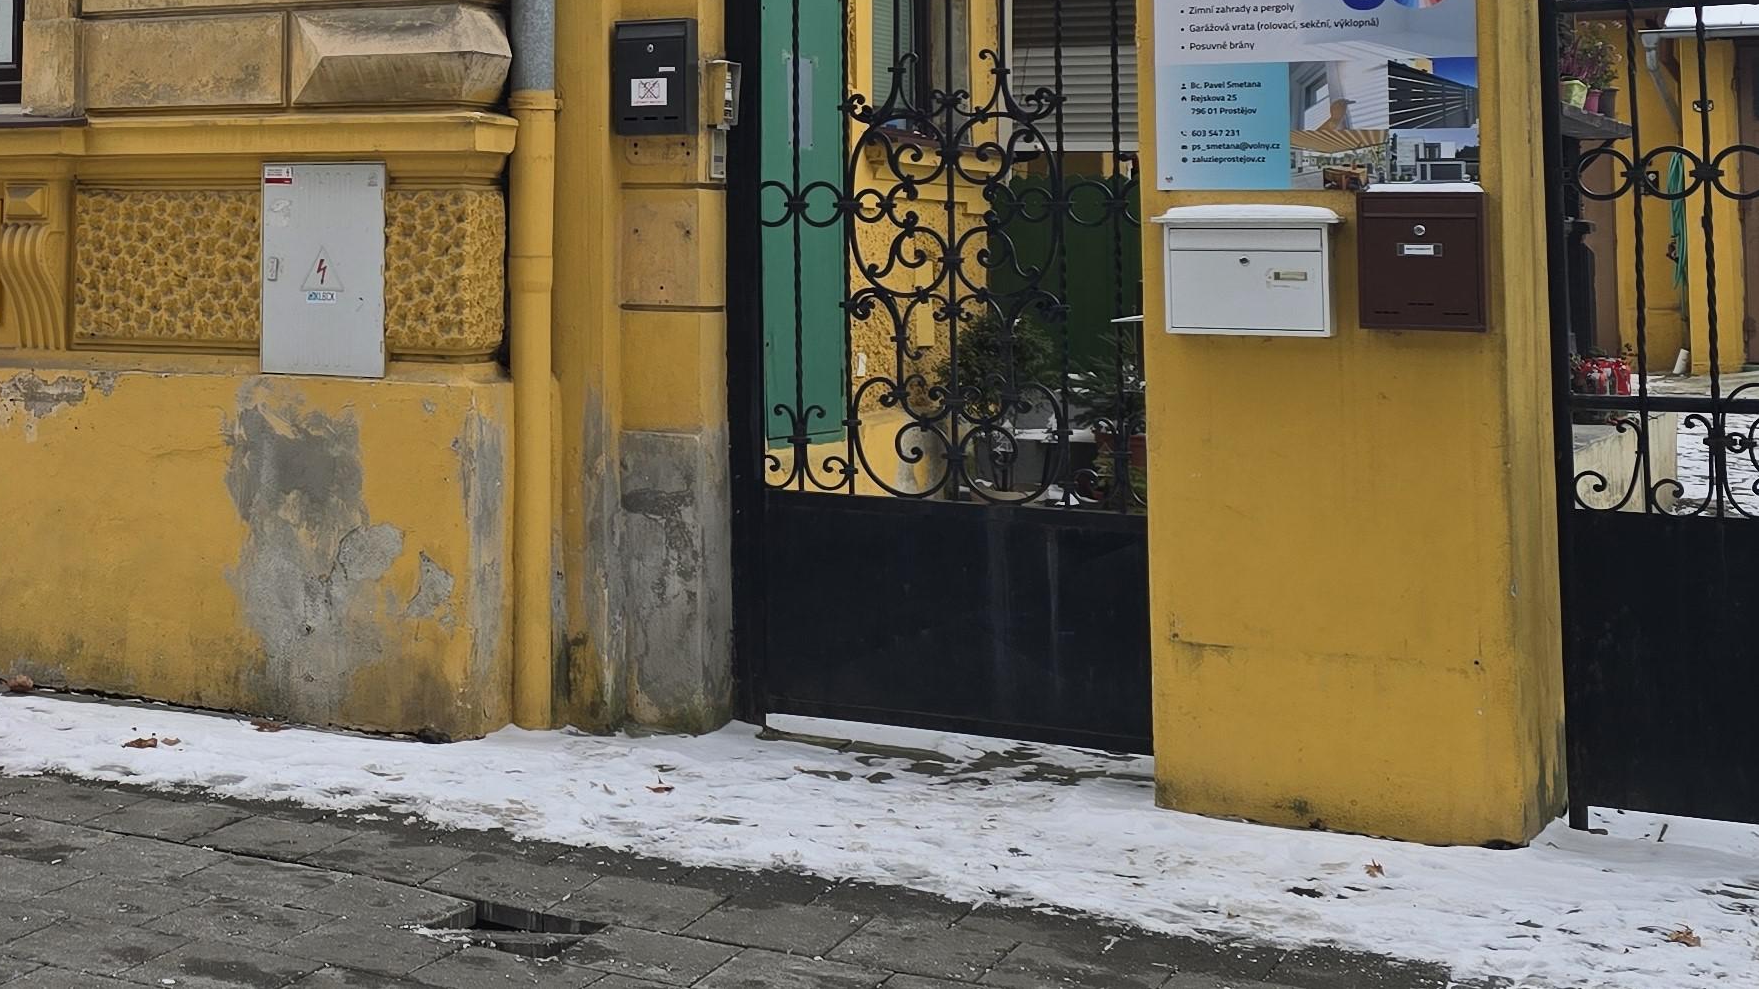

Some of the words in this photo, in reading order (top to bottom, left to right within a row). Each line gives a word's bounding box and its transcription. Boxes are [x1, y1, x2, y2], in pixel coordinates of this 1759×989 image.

[1188, 5, 1214, 14] Zimní
[1215, 4, 1251, 13] zahrady
[1260, 3, 1294, 13] pergoly
[1189, 23, 1229, 32] Garážová
[1256, 20, 1297, 30] (rolovací,
[1299, 19, 1331, 28] sekční,
[1333, 17, 1379, 28] výklopná)
[1189, 41, 1227, 50] Posuvné
[1229, 40, 1254, 49] brány
[1190, 81, 1202, 89] Bc.
[1226, 80, 1261, 88] Smetana
[1190, 94, 1225, 102] Rejskova
[1226, 93, 1237, 101] 25
[1219, 107, 1257, 115] Prostějov
[1191, 142, 1280, 151] ps_smetana@volny.cz
[1191, 155, 1265, 163] zaluzieprostejov.cz
